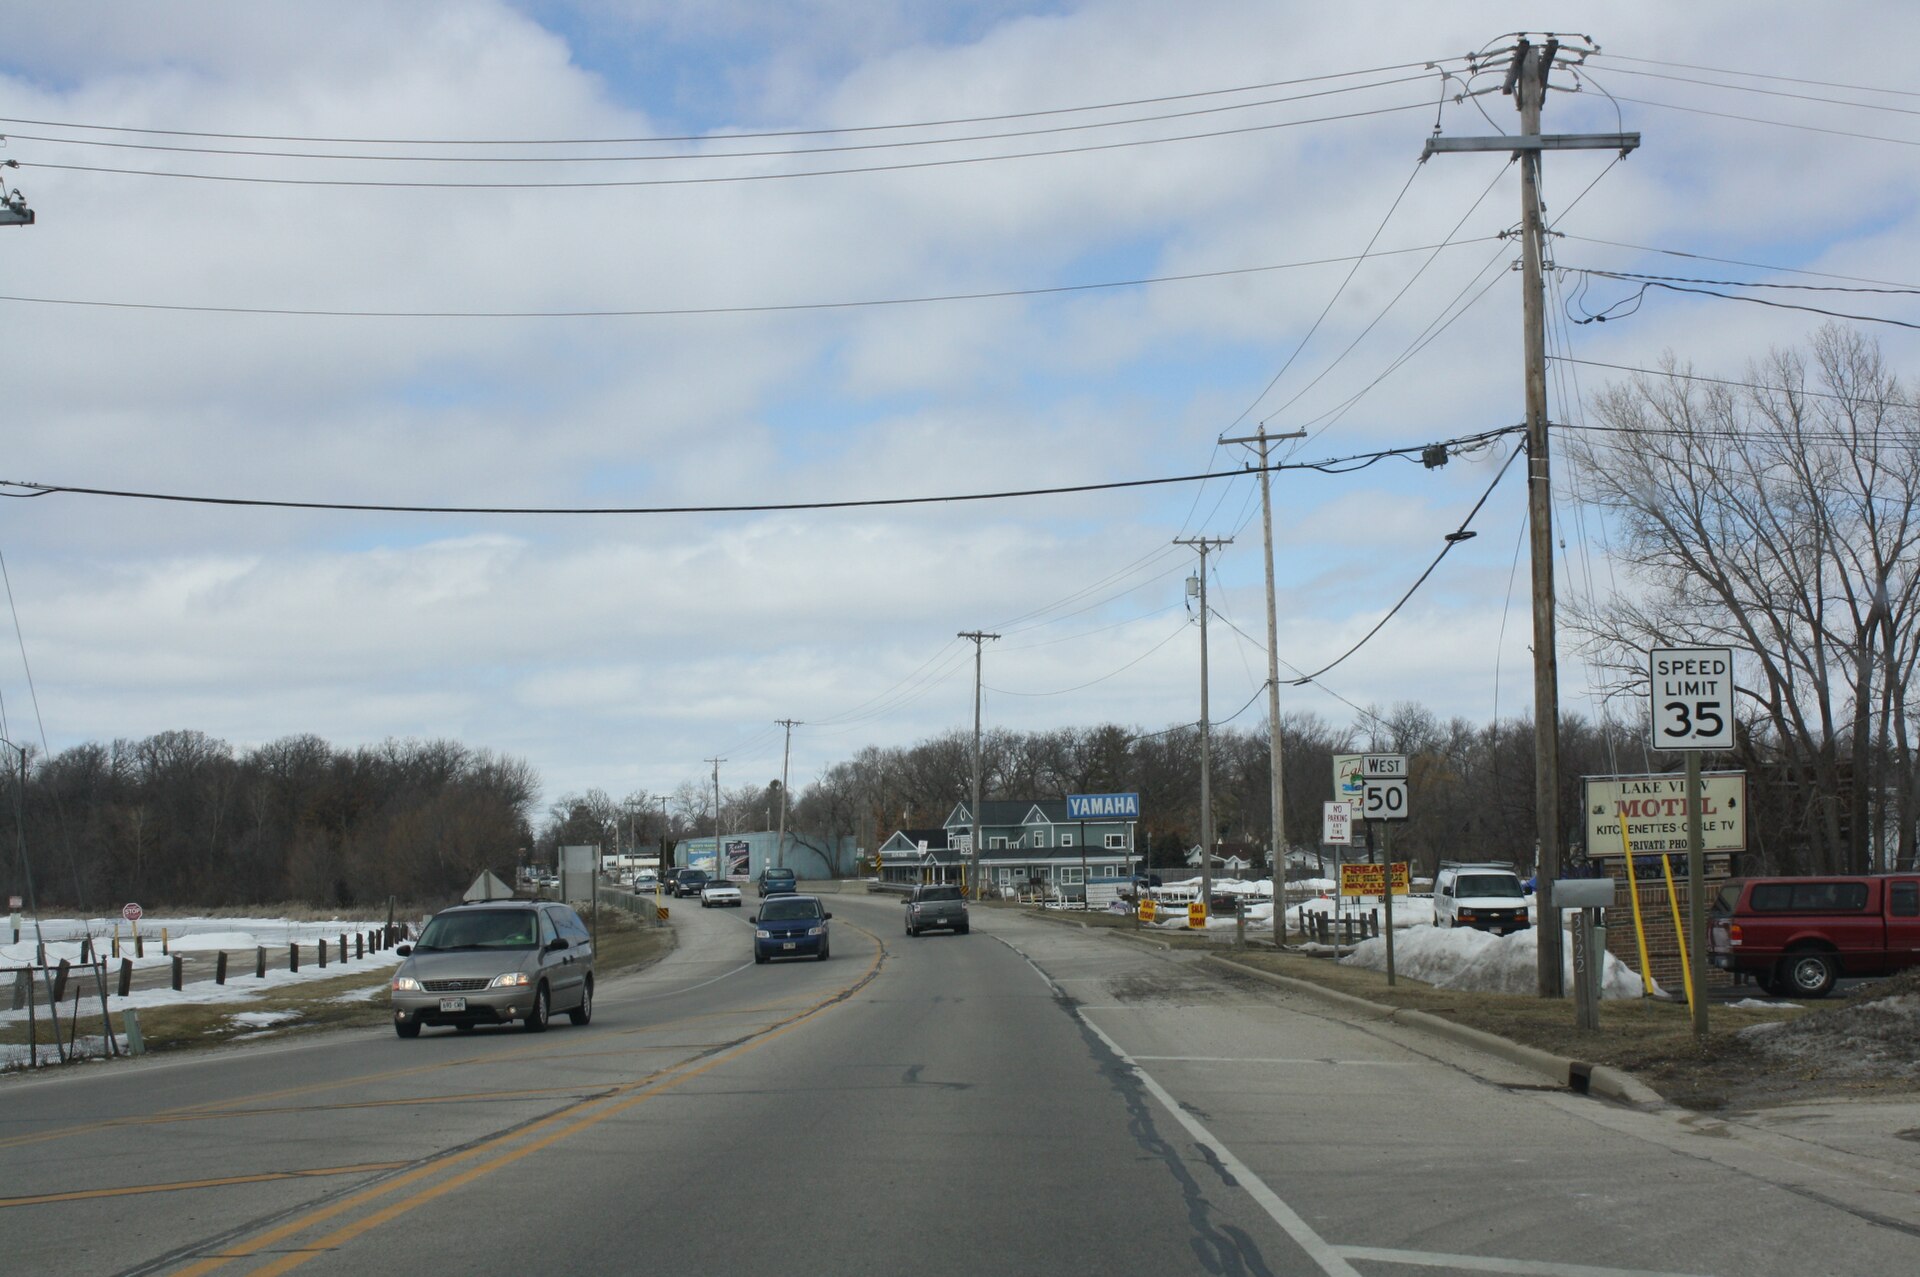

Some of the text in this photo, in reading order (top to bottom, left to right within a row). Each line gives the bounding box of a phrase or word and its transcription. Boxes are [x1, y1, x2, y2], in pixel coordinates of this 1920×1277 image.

[1658, 660, 1725, 675] SPEED
[1665, 681, 1718, 696] LIMIT
[1664, 702, 1723, 737] 35
[1368, 759, 1400, 773] WEST
[1622, 779, 1710, 795] LAKE VIW
[1368, 787, 1402, 811] 50
[1070, 796, 1136, 816] YAMAHA
[1332, 805, 1343, 813] NO
[1327, 814, 1348, 822] PARKING
[1721, 821, 1735, 831] TV
[1628, 839, 1665, 851] PRIVATE
[1143, 901, 1154, 909] SALE
[1191, 904, 1203, 914] SALE
[1140, 911, 1154, 920] TODAY
[1190, 918, 1205, 927] TODAY
